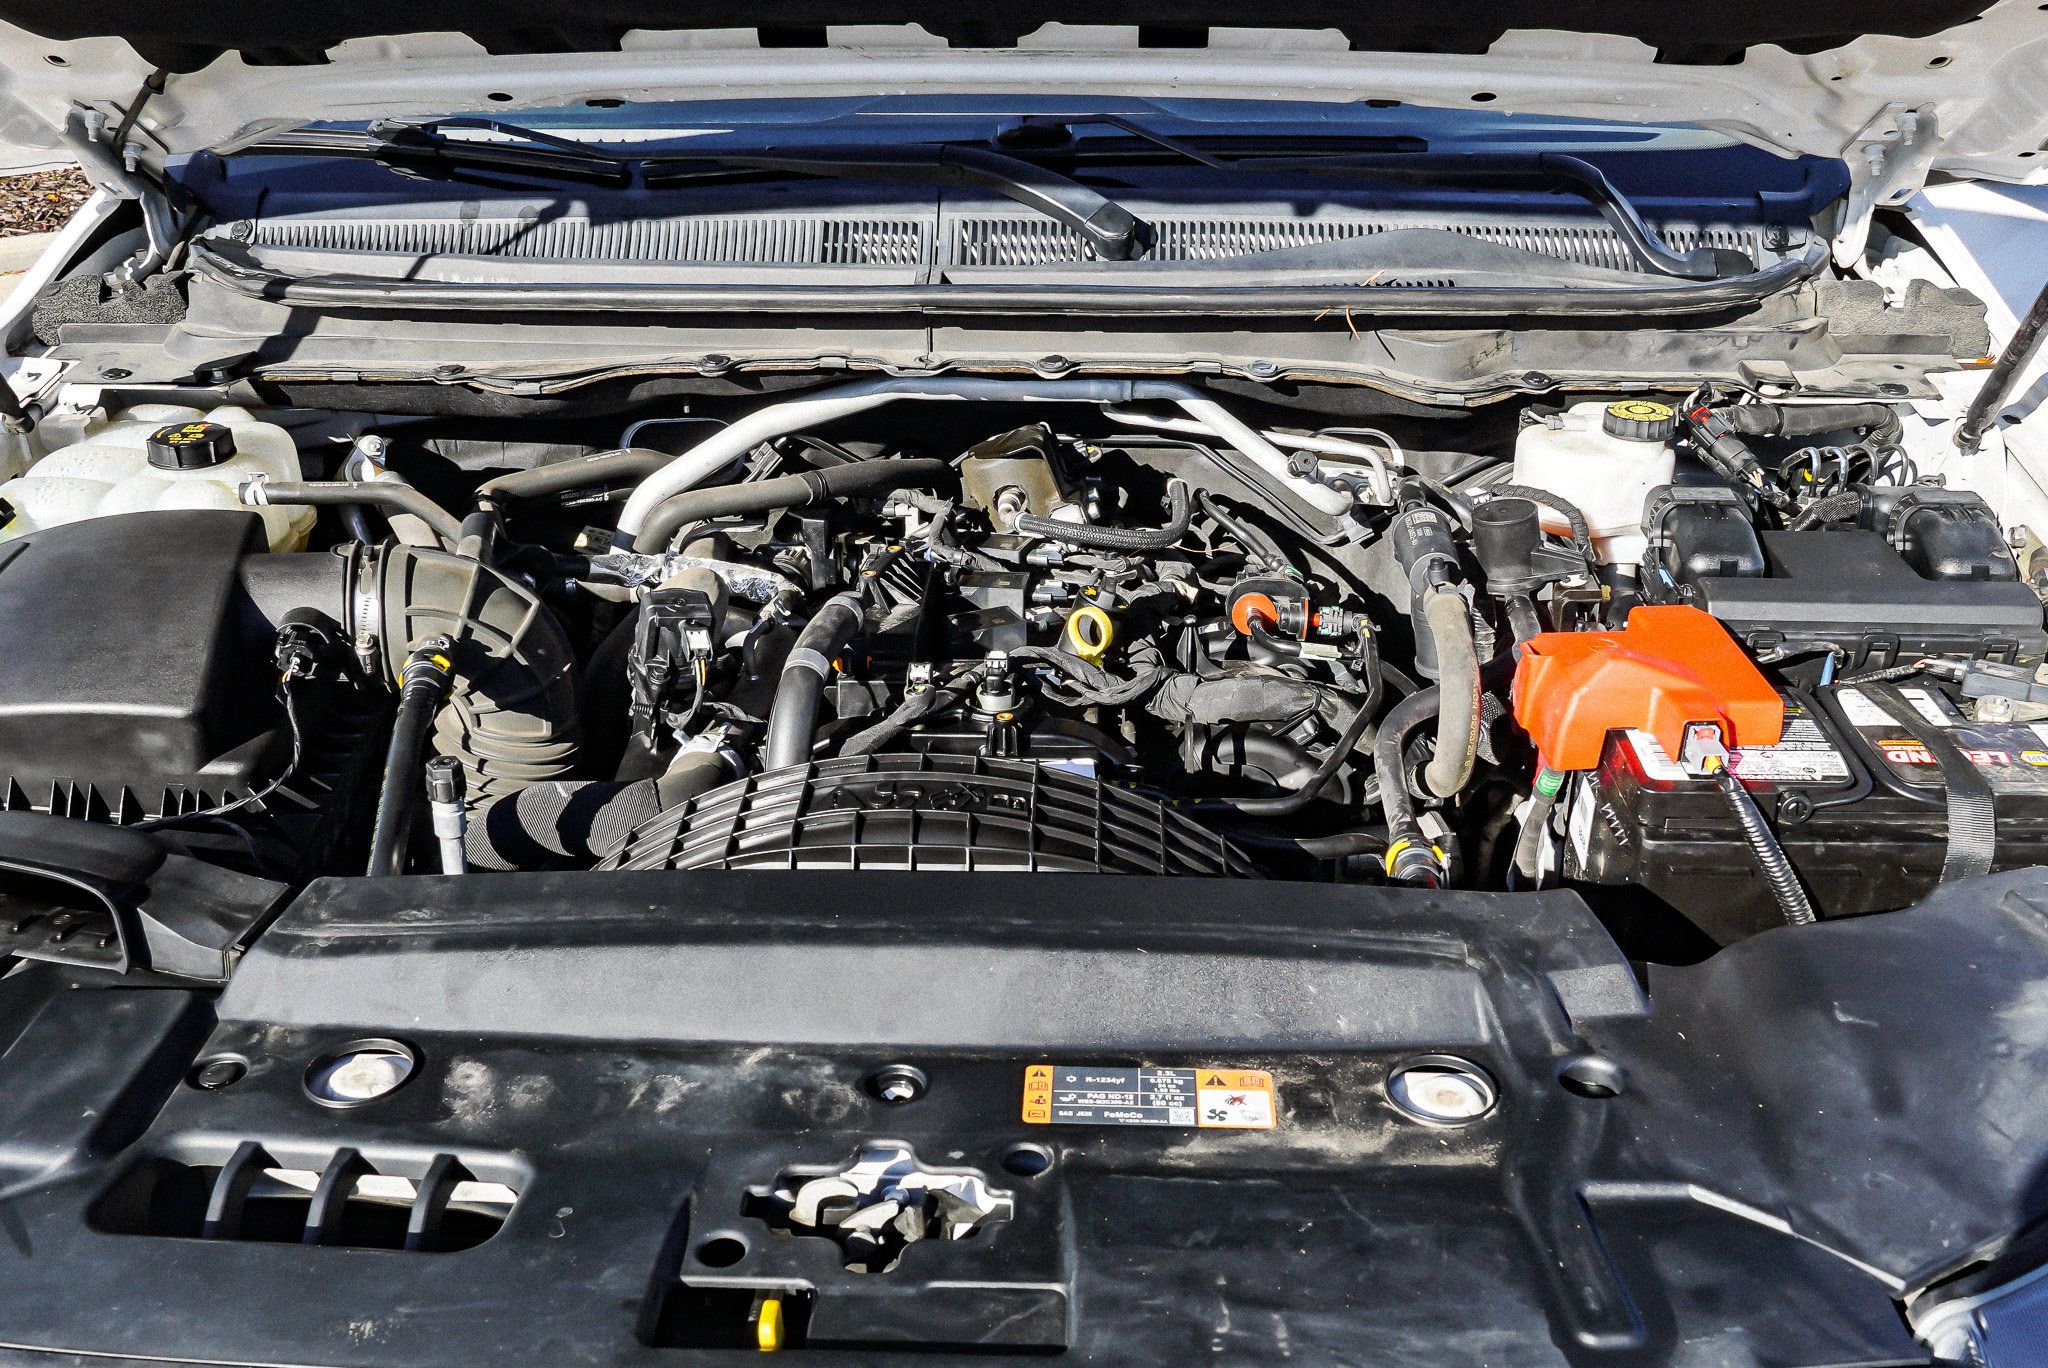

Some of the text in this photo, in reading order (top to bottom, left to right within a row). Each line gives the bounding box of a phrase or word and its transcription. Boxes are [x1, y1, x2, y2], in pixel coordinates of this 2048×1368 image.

[1466, 714, 1478, 756] 02/03/20
[1886, 750, 2010, 766] LEND
[1085, 1076, 1125, 1084] R-1234yf
[1173, 1078, 1184, 1086] kg
[1152, 1099, 1167, 1107] (80
[1103, 1111, 1143, 1119] FoMoCo
